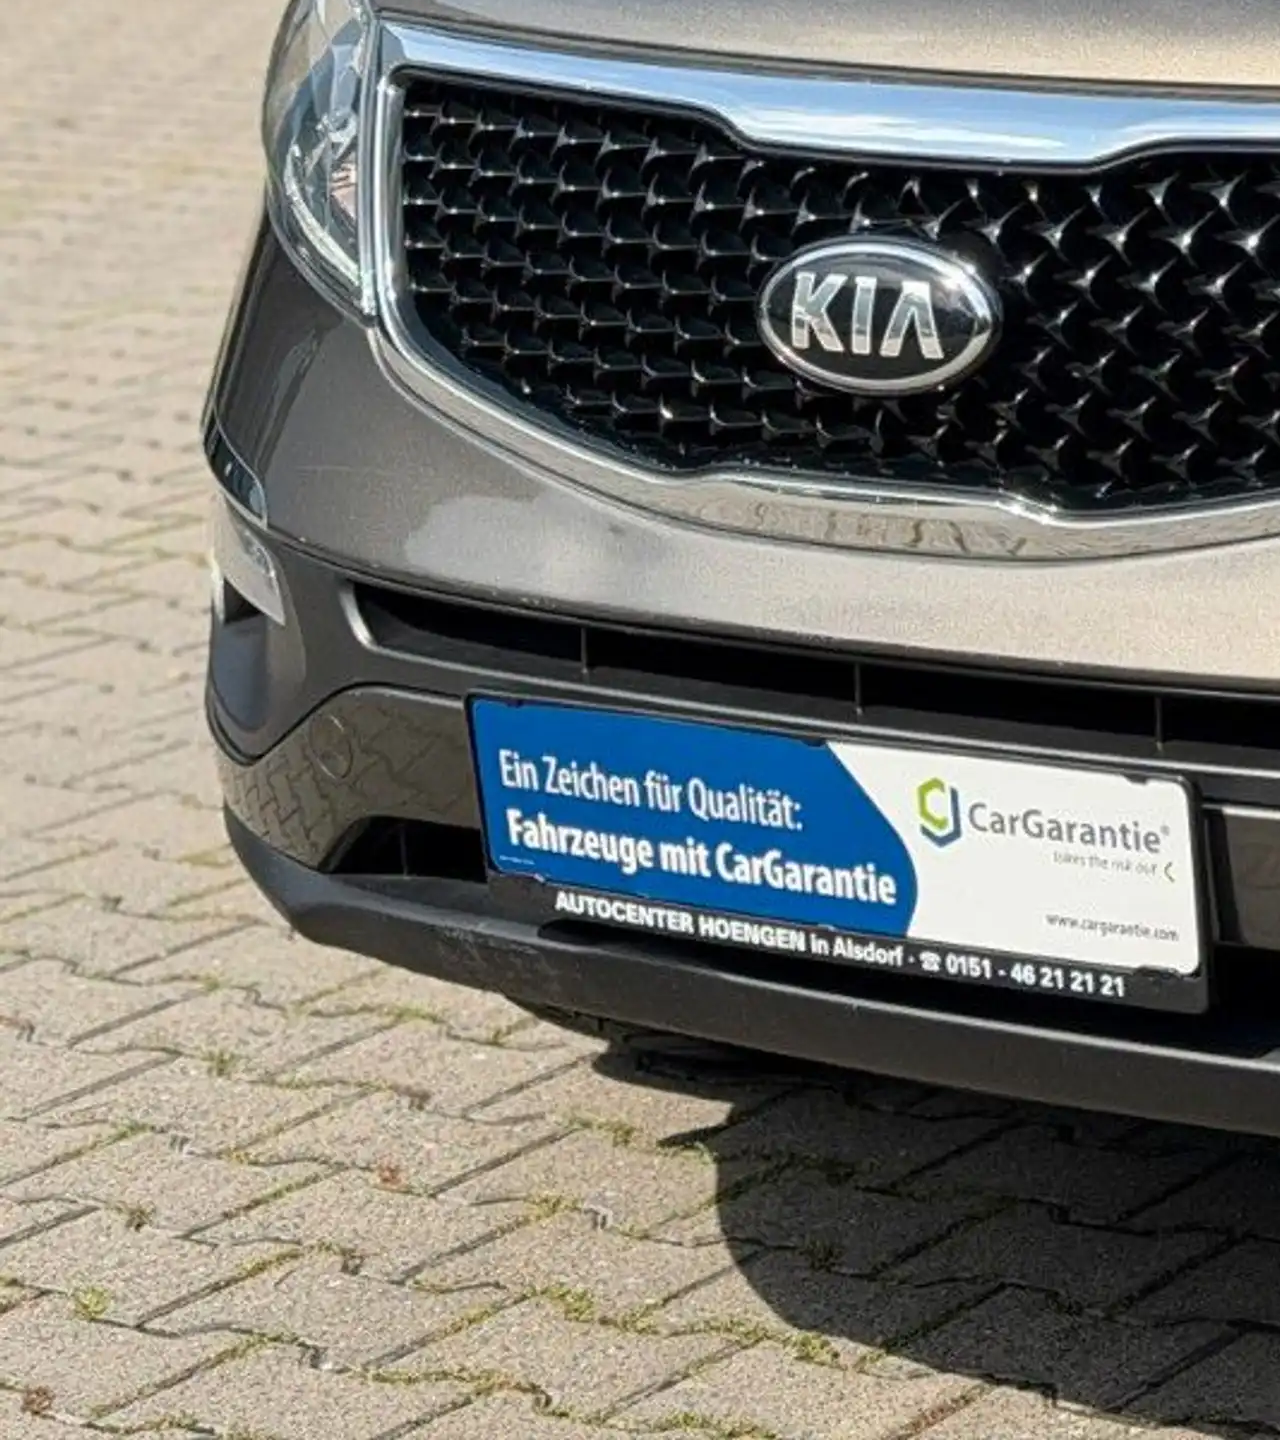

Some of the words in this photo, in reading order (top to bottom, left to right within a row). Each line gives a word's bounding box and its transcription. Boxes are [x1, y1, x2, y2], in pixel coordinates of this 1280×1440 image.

[791, 271, 944, 359] KIA
[499, 748, 539, 792] Ein
[542, 755, 640, 808] Zeichen
[644, 769, 682, 812] für
[688, 777, 803, 831] Qualität:
[507, 808, 654, 876] Fahrzeuge
[659, 835, 711, 878] mit
[715, 841, 897, 906] CarGarantie
[555, 890, 694, 934] AUTOCENTER
[699, 915, 805, 952] HOENGEN
[811, 934, 830, 957] in
[833, 938, 903, 966] Alsdorf
[946, 952, 992, 980] 0151
[1010, 962, 1036, 986] 46
[1039, 967, 1065, 991] 21
[1069, 971, 1095, 994] 21
[1099, 975, 1126, 998] 21
